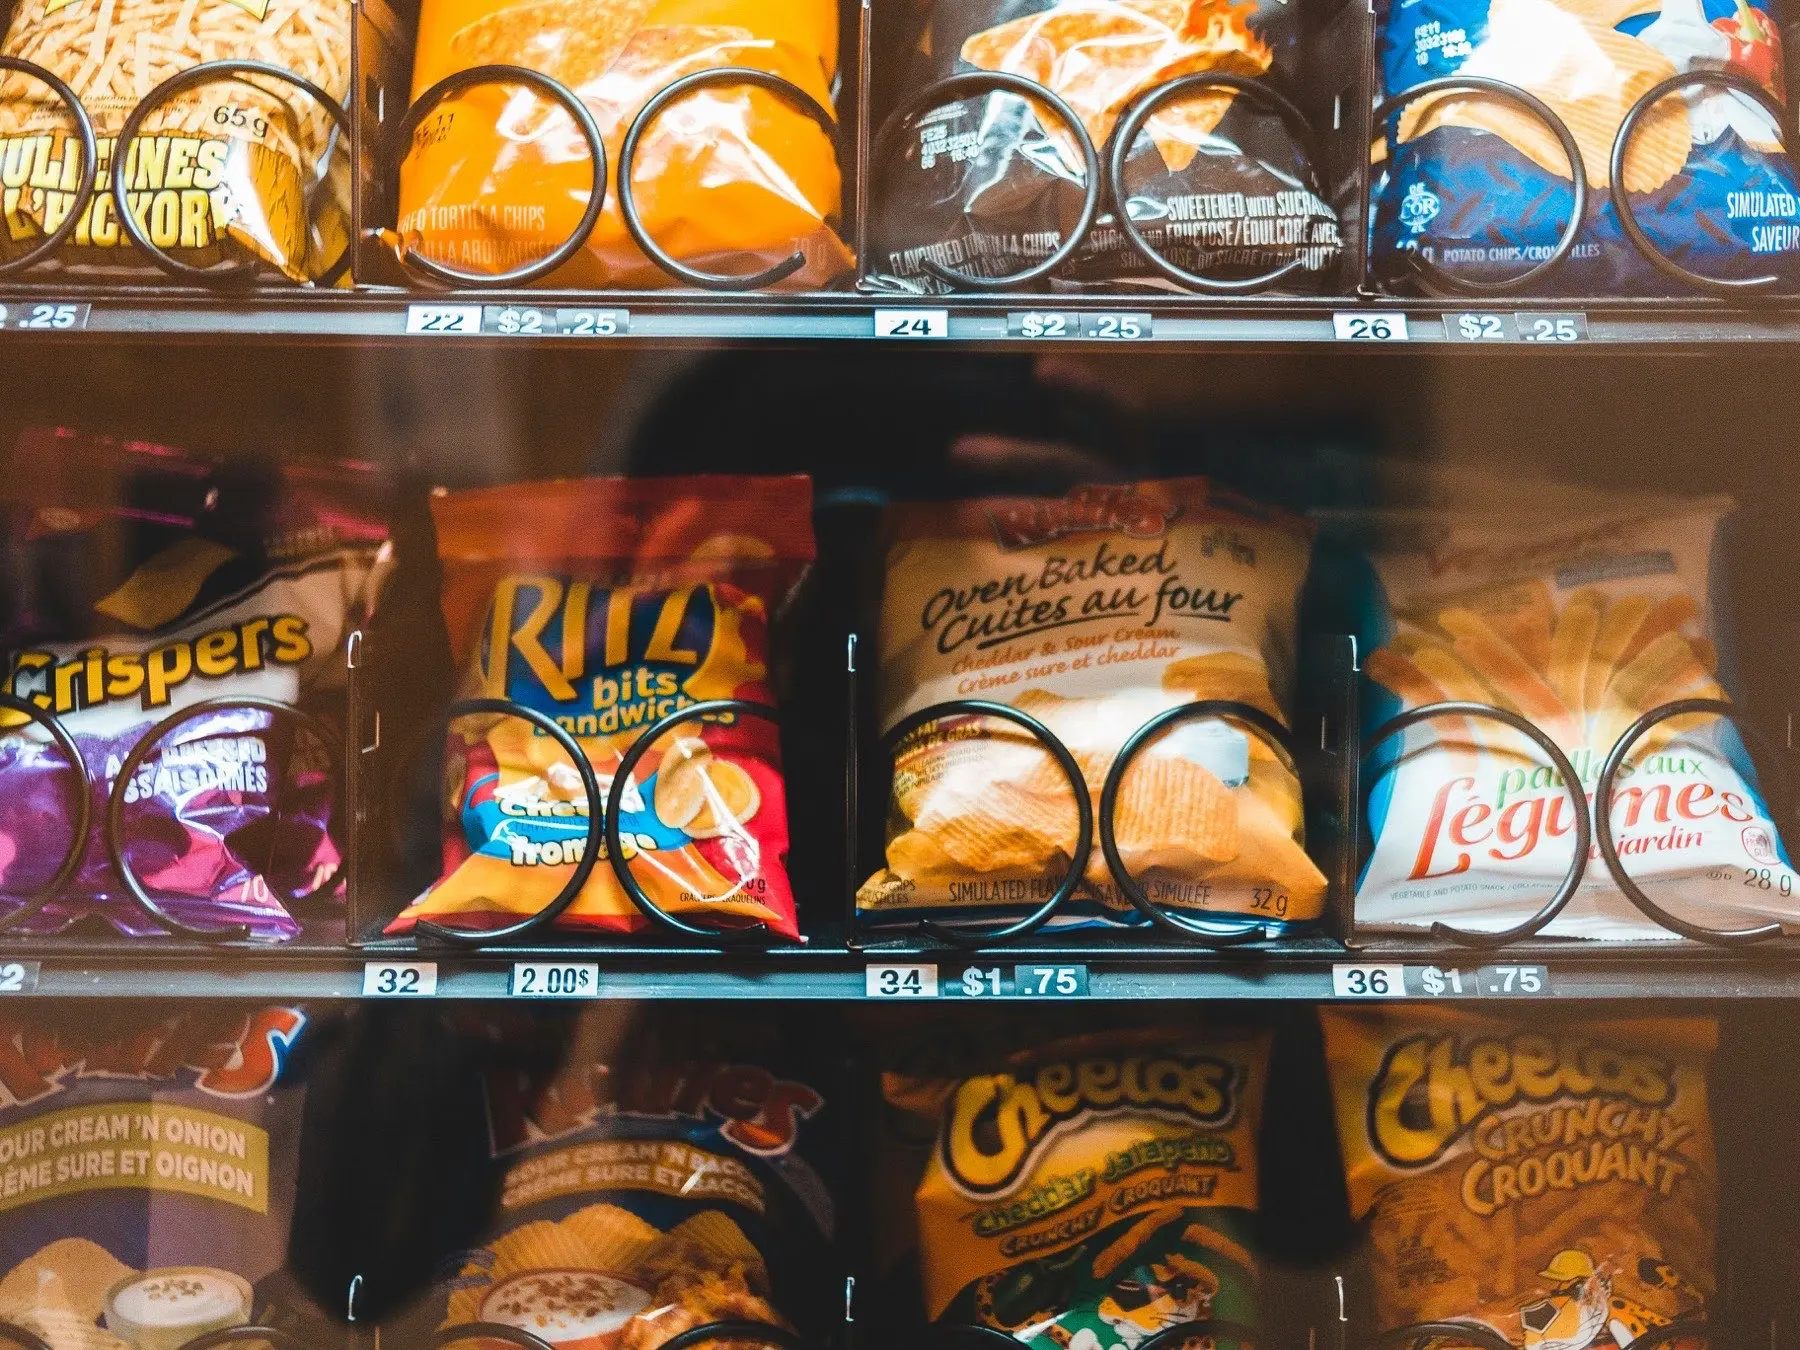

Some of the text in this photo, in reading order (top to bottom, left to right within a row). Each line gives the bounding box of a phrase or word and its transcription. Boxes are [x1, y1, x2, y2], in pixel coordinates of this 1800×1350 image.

[213, 106, 246, 128] 65
[253, 117, 269, 138] g
[431, 204, 497, 232] TORTILLA
[504, 206, 545, 232] CHIPS
[1166, 192, 1244, 221] SWEETENED
[1245, 196, 1276, 217] WITH
[1727, 191, 1797, 218] SIMULATED
[1022, 231, 1061, 257] CHIPS
[1752, 225, 1800, 252] SAVEUR
[1443, 248, 1485, 263] POTATO
[19, 305, 77, 329] .25
[421, 311, 617, 335] 22 $2 .25
[888, 314, 1141, 338] 24 $2 .25
[1350, 315, 1578, 342] 26 $2 .25
[921, 574, 1036, 630] Oven
[1040, 539, 1177, 590] Baked
[937, 575, 1243, 655] Cuites au four
[486, 573, 701, 701] RITZ
[1025, 660, 1069, 681] sure
[1071, 656, 1092, 671] et
[1096, 640, 1184, 666] cheddar
[592, 666, 678, 711] bits
[1645, 752, 1709, 779] aux
[1612, 825, 1702, 858] jardin
[757, 878, 766, 893] g
[948, 880, 1027, 902] SIMULATED
[1743, 867, 1791, 897] 28 g
[1153, 880, 1212, 905] SIMULÉE
[1250, 887, 1281, 909] 32
[1275, 893, 1288, 917] g
[377, 967, 590, 994] 32 2.00$
[879, 966, 1078, 995] 34 $1 .75
[1346, 967, 1542, 997] 36 $1 .75
[0, 1114, 247, 1165] OUR CREAM 'N ONION
[1473, 1102, 1695, 1160] CRUNCHY
[56, 1149, 116, 1183] SURE
[119, 1150, 151, 1176] ET
[155, 1151, 255, 1198] OIGNON
[1461, 1141, 1686, 1216] CROQUANT
